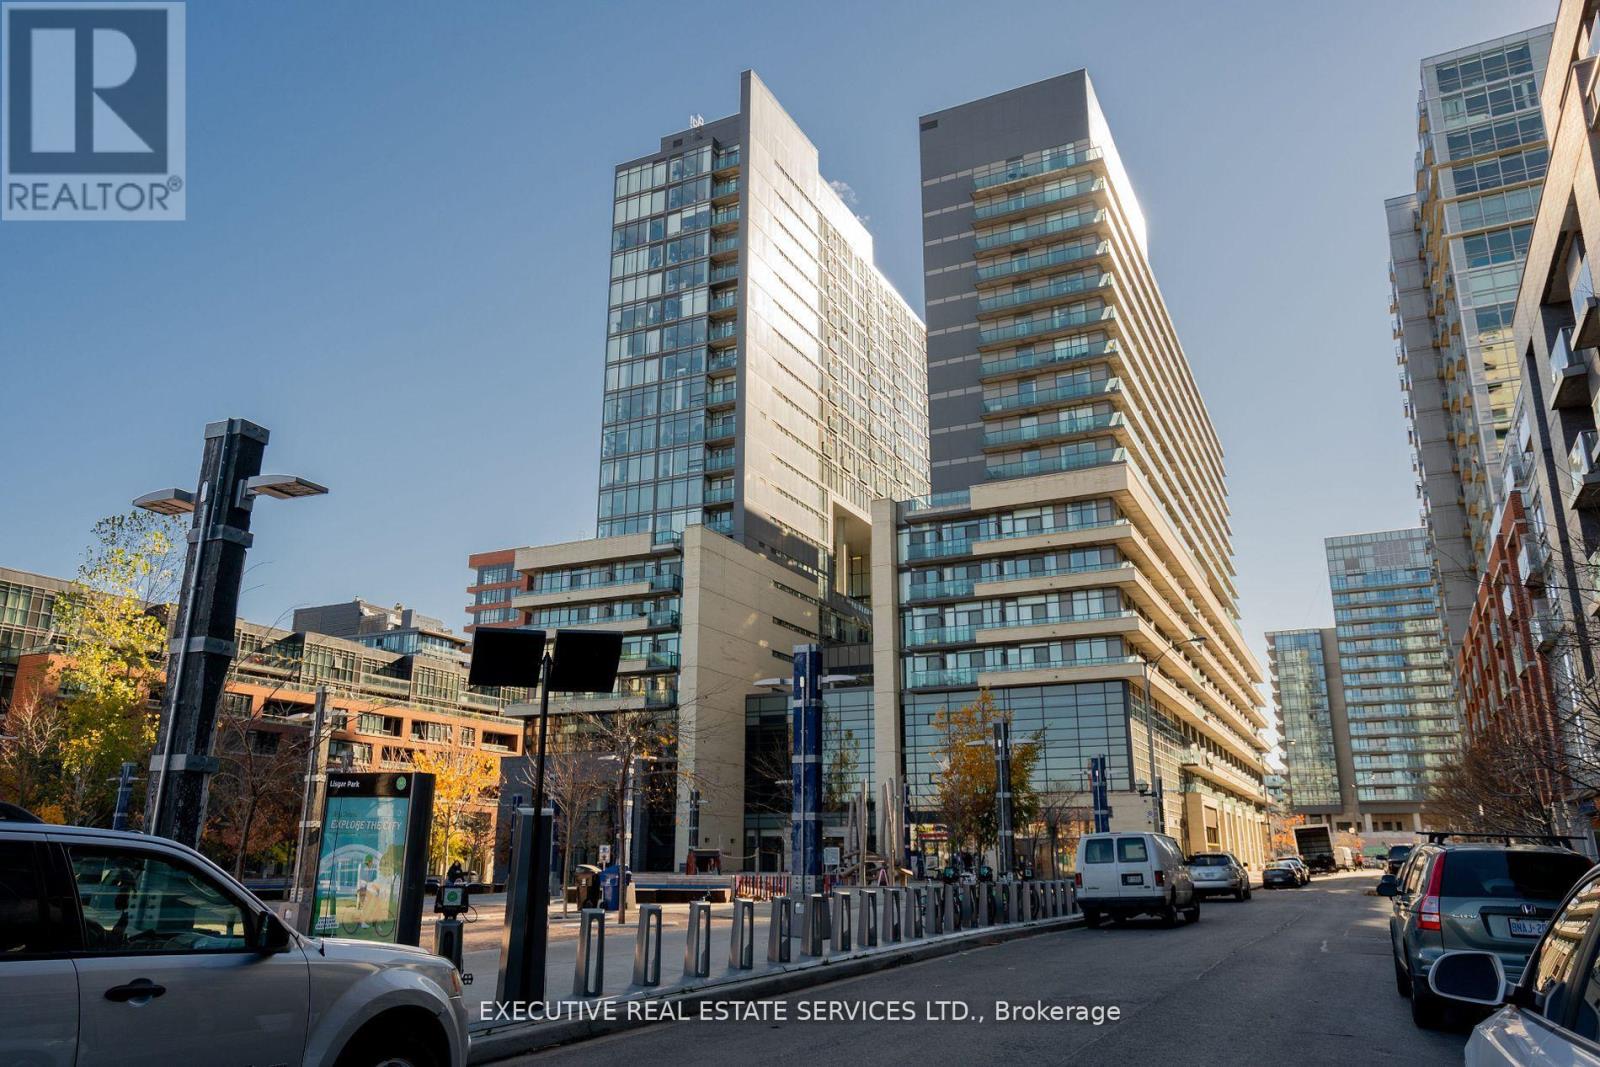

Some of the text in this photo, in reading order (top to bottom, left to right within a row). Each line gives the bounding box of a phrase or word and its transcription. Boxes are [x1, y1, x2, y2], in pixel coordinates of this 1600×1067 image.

[347, 780, 360, 788] Park
[330, 819, 402, 831] EXPLORE THE CITY
